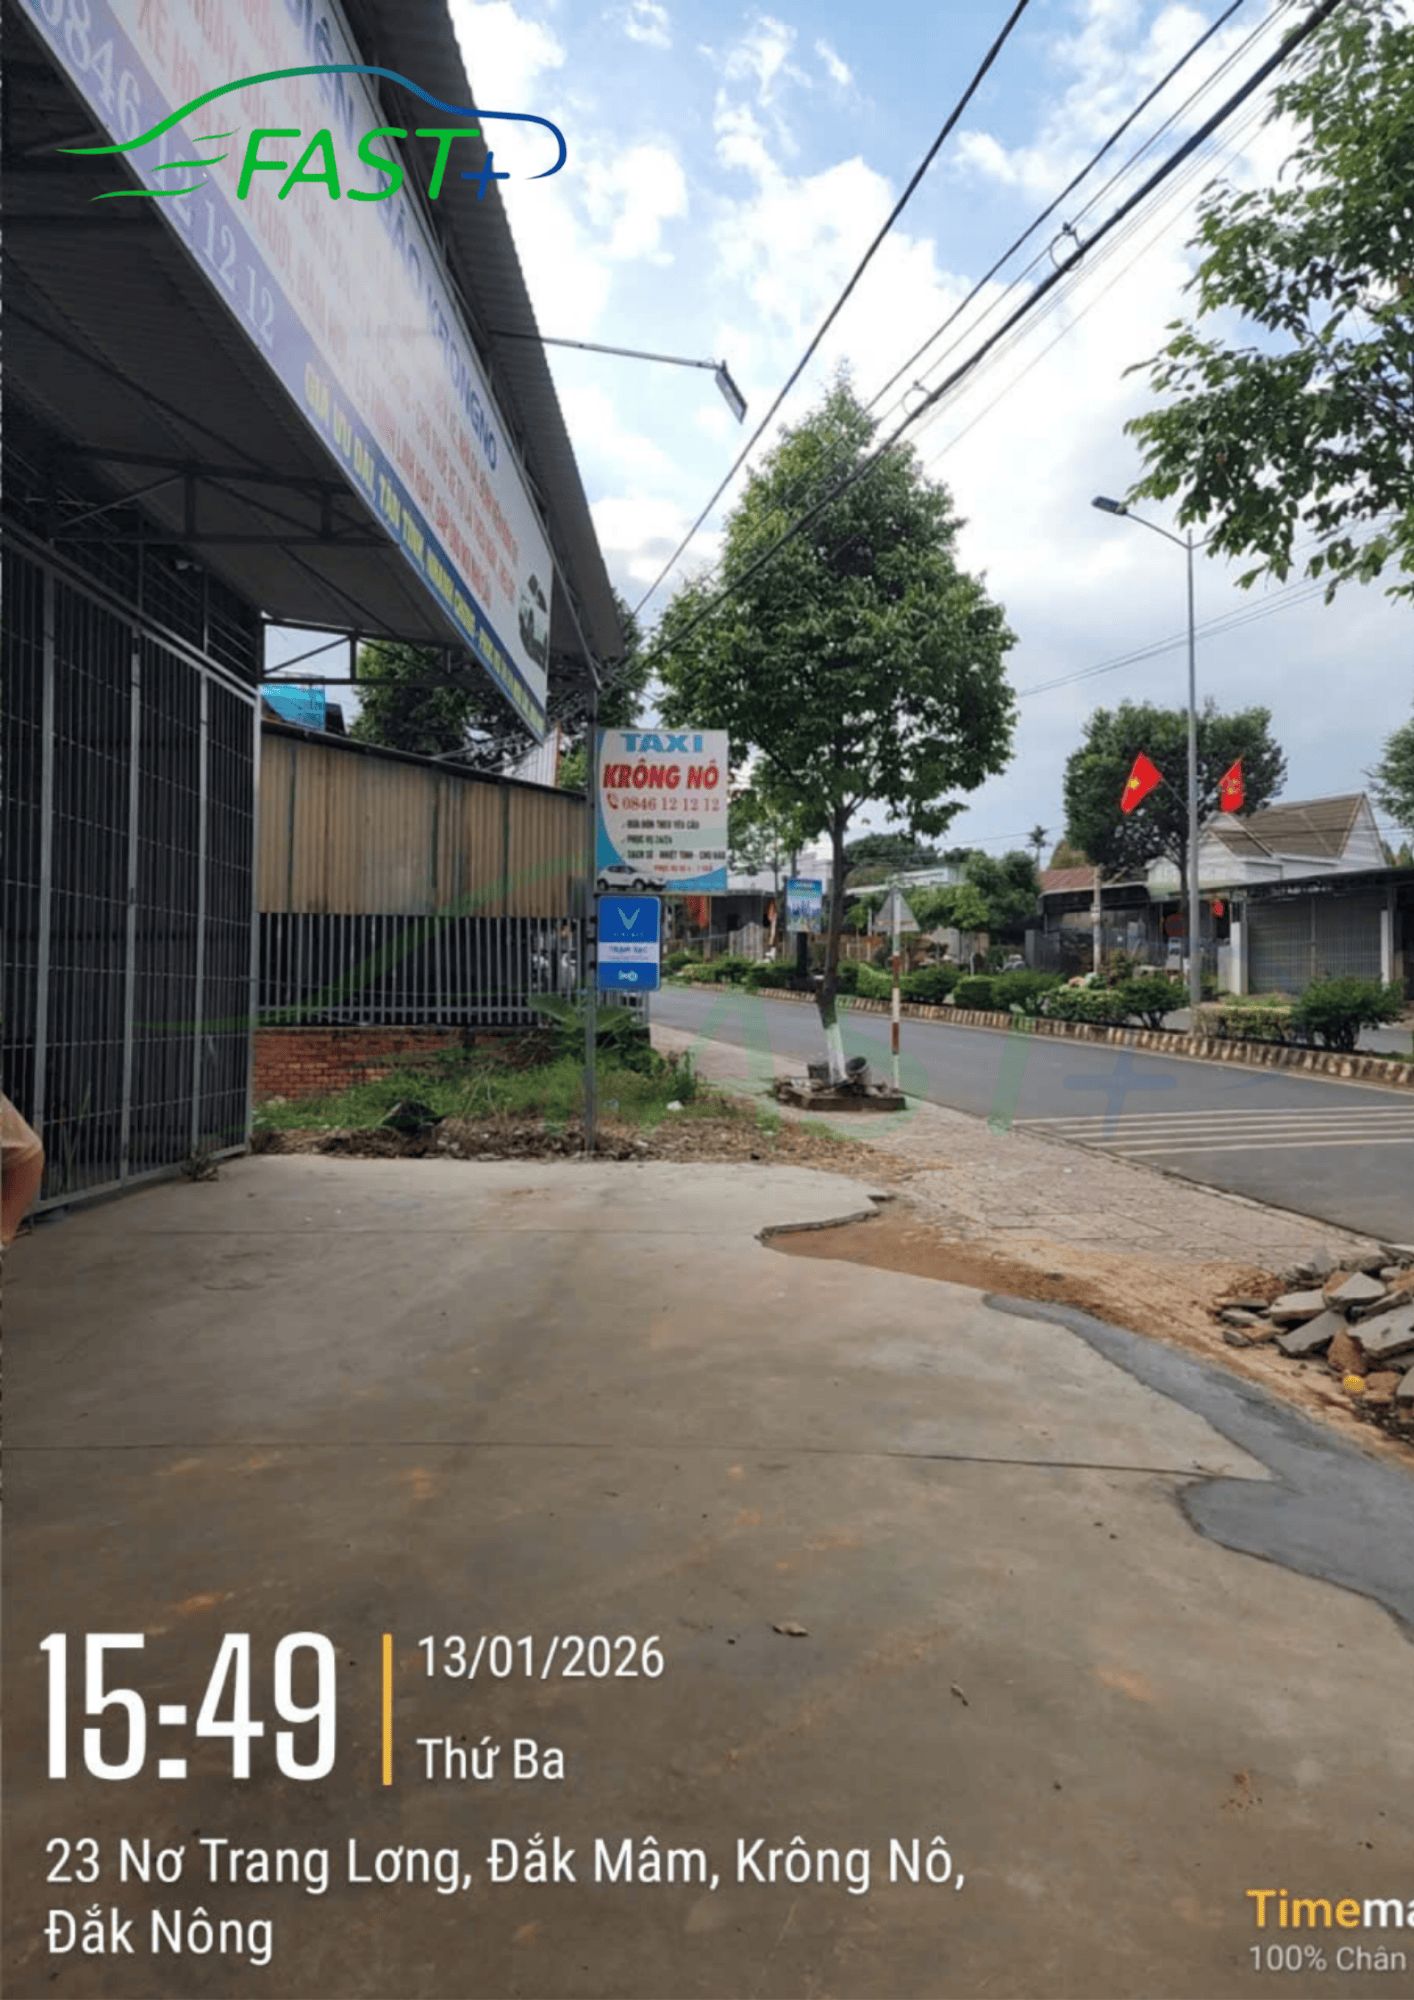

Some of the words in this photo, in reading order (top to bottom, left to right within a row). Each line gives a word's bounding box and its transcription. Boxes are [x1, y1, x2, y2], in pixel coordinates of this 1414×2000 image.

[204, 201, 236, 291] 12
[246, 265, 276, 349] 12
[620, 733, 703, 752] TAXI
[603, 758, 681, 789] KRÔNG
[687, 758, 719, 790] NÔ
[622, 797, 657, 811] 0846
[662, 797, 678, 811] 12
[683, 797, 699, 812] 12
[704, 797, 720, 812] 12
